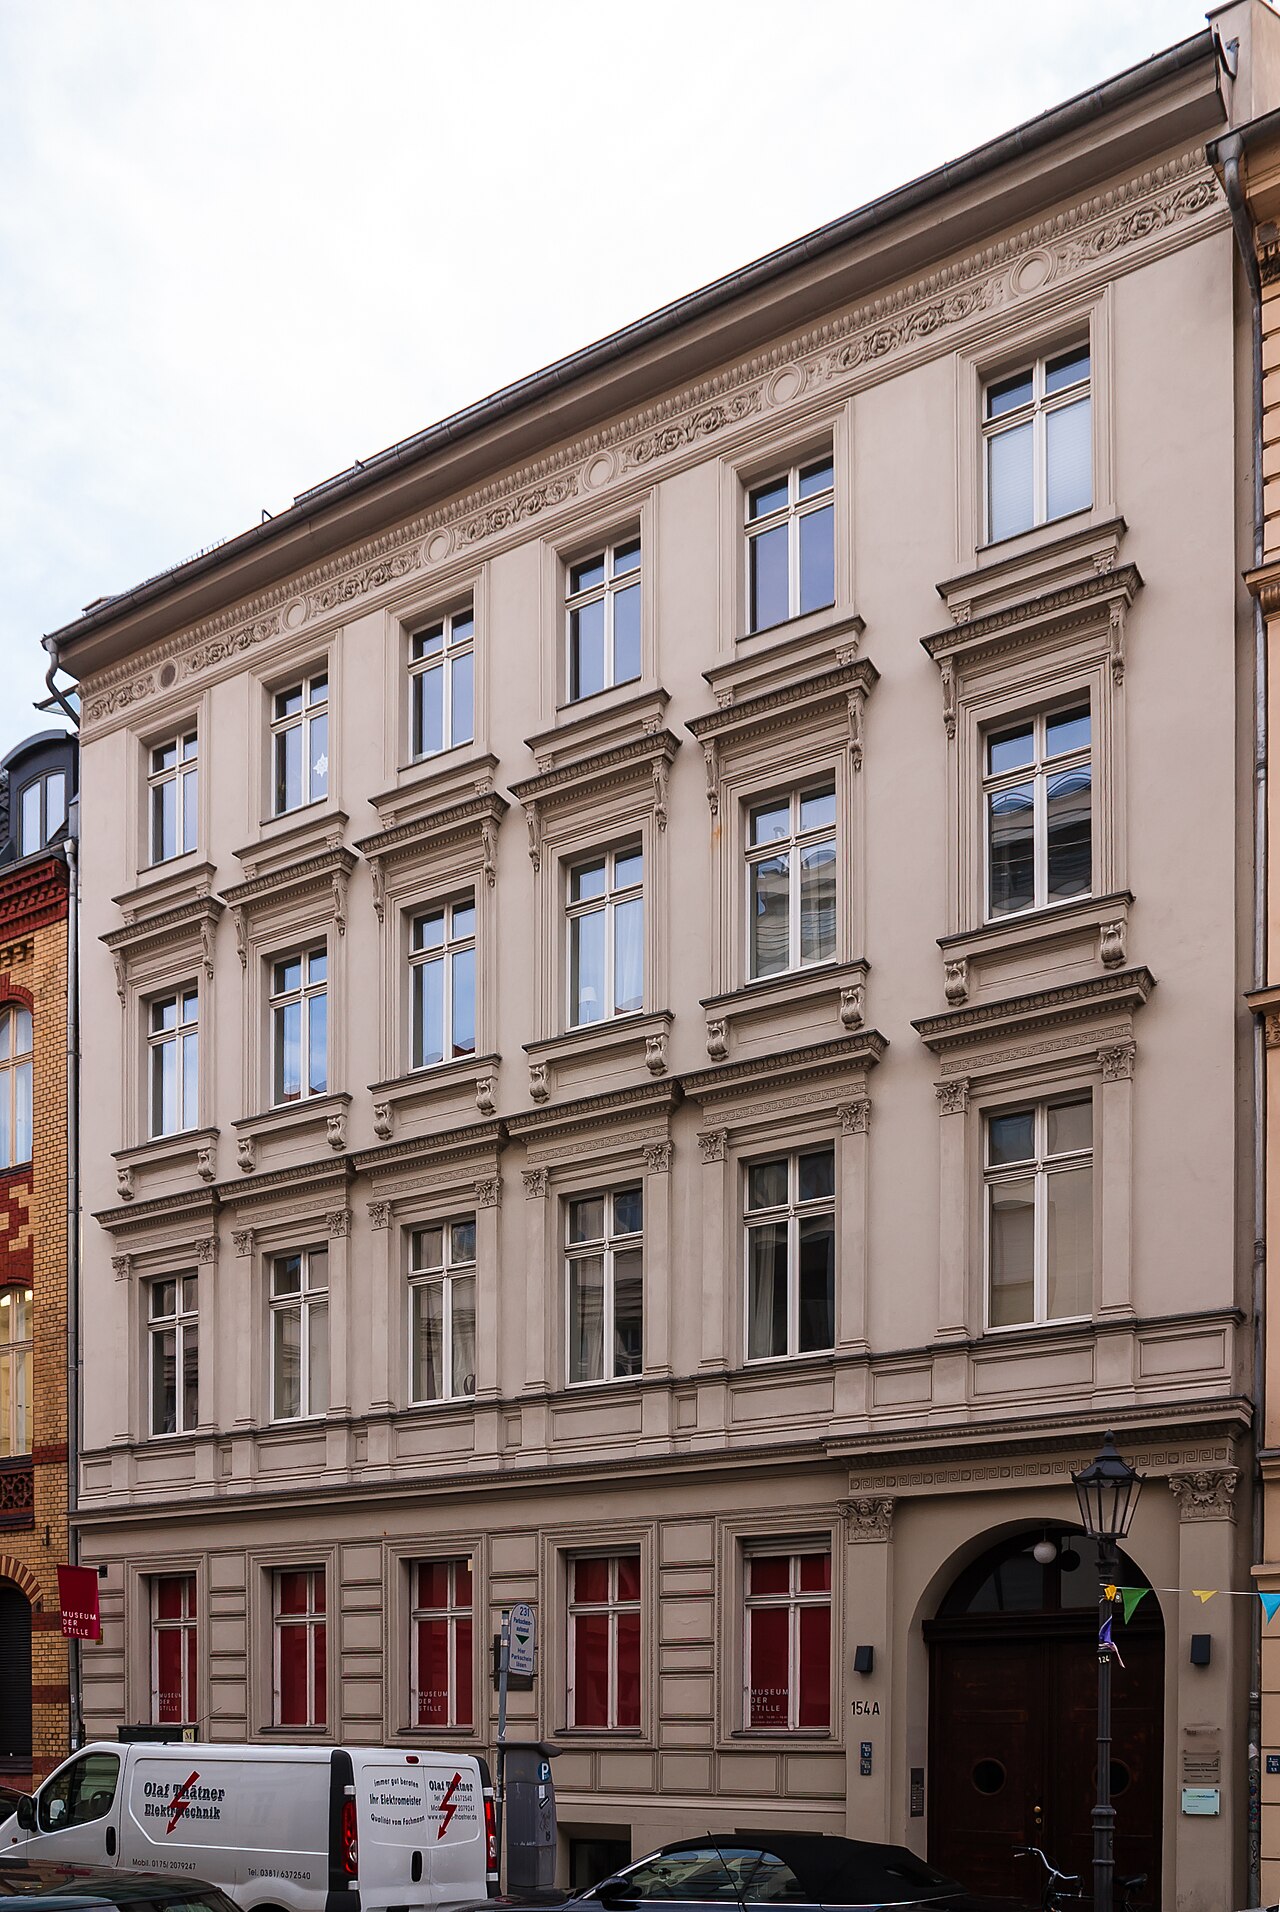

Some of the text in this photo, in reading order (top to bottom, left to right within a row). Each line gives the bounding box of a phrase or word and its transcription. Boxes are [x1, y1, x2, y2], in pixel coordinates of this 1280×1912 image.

[63, 1611, 96, 1620] MUSEUM
[520, 1607, 530, 1617] 231
[63, 1627, 88, 1635] STILLE
[851, 1701, 880, 1715] 154A
[541, 1763, 549, 1780] P
[144, 1782, 170, 1798] Olaf
[429, 1781, 444, 1791] Olaf
[370, 1793, 421, 1805] Ihr Elektromeister
[145, 1804, 220, 1819] Elektrtechnik
[248, 1868, 258, 1876] Tel.
